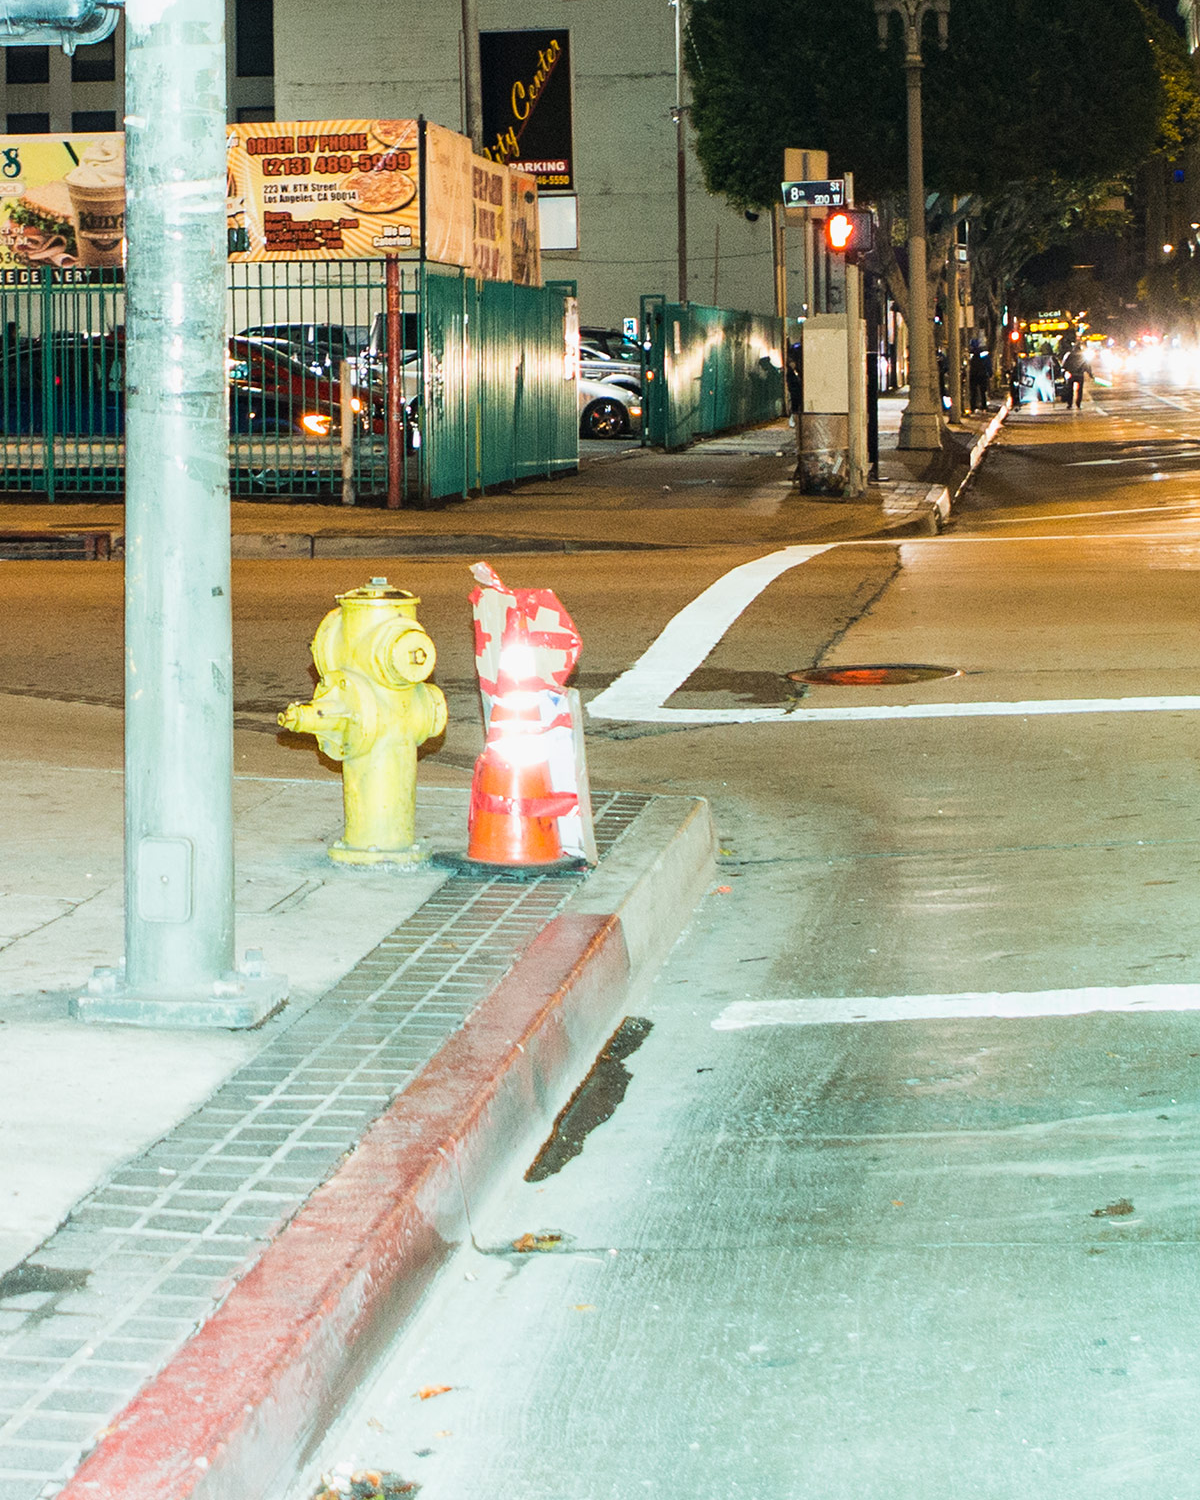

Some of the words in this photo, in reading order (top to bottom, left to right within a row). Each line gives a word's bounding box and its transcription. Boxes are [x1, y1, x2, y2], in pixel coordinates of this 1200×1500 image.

[511, 39, 561, 121] Center
[247, 136, 295, 156] ORDER
[297, 135, 317, 153] BY
[319, 133, 368, 152] PHONE
[262, 157, 311, 176] (213)
[263, 184, 279, 193] 223
[311, 182, 337, 192] Street
[829, 182, 840, 192] St
[263, 194, 278, 204] Los
[317, 192, 329, 202] CA
[814, 194, 831, 205] 200
[832, 194, 841, 204] W
[13, 223, 26, 235] of
[20, 270, 92, 283] DEVERY
[1038, 310, 1062, 318] Local
